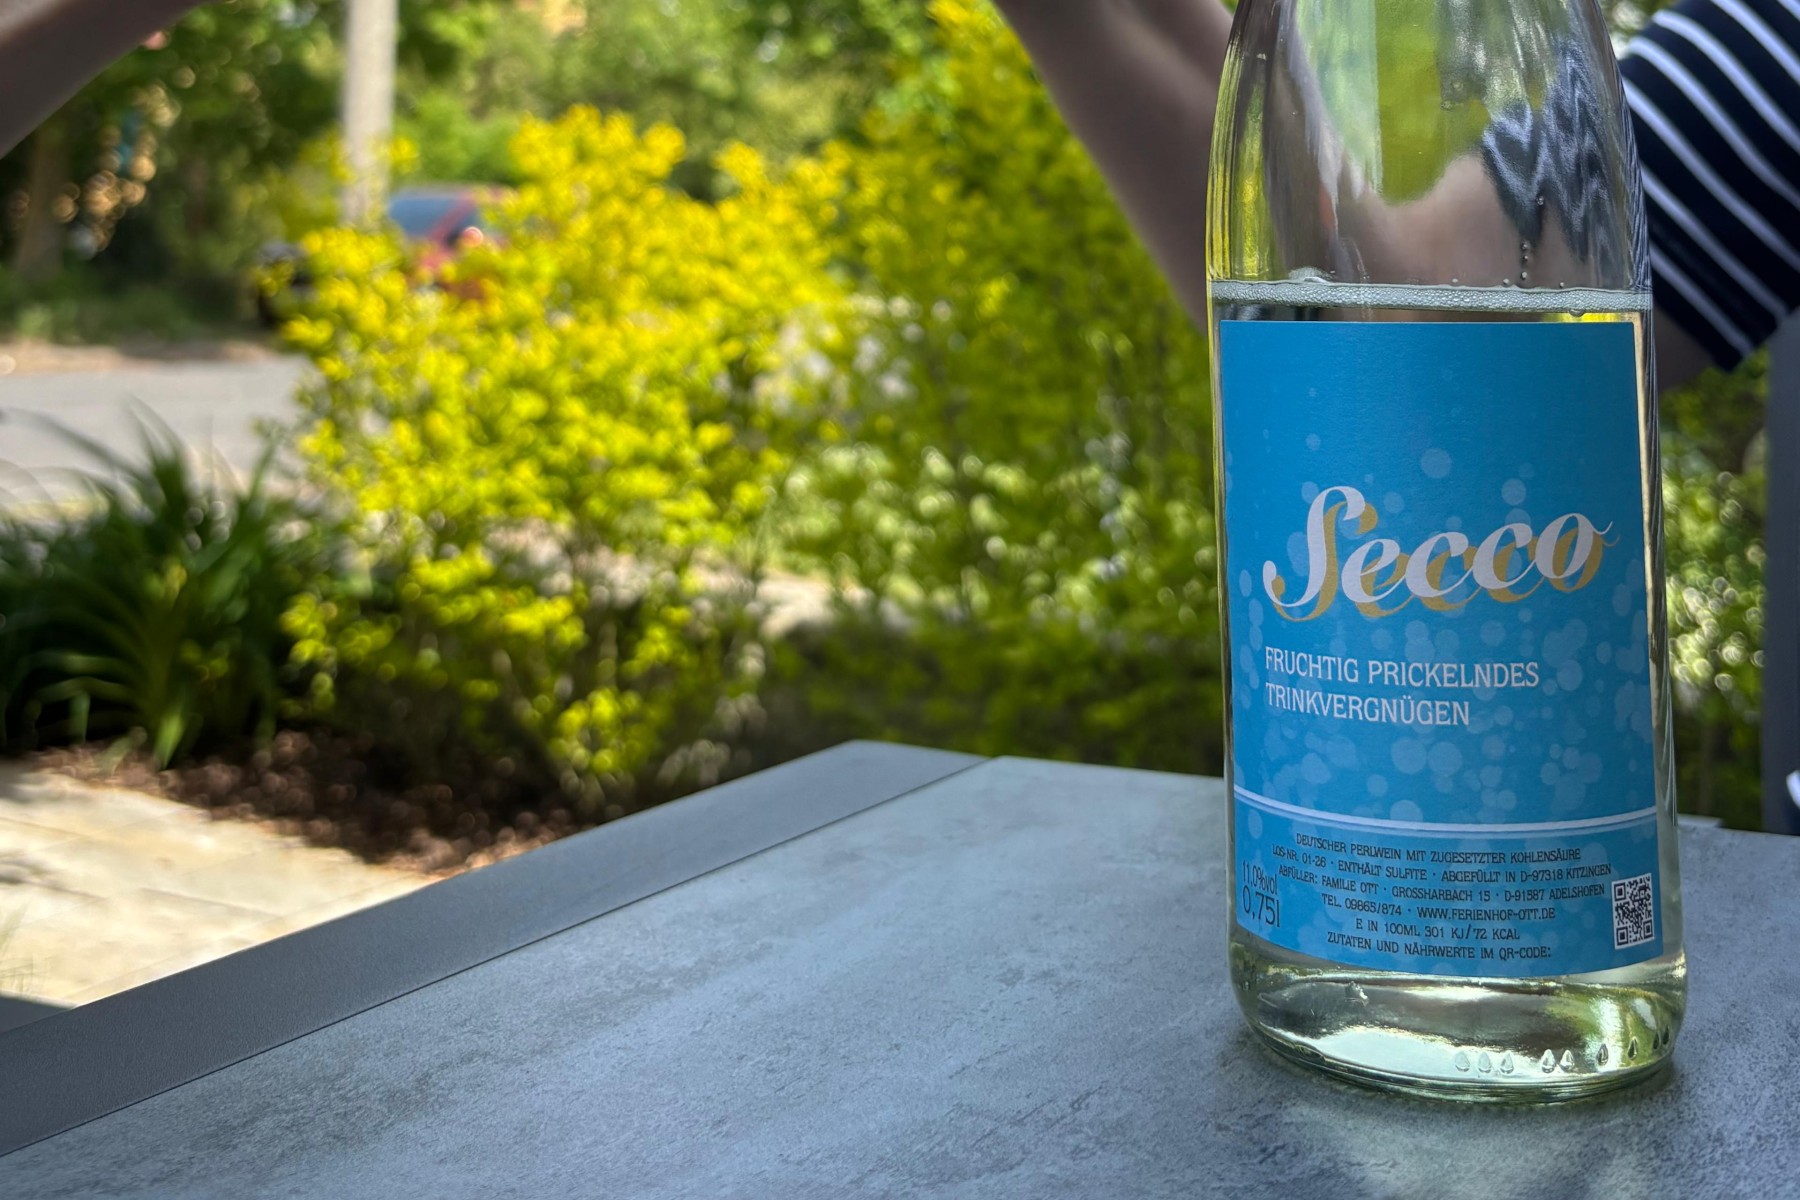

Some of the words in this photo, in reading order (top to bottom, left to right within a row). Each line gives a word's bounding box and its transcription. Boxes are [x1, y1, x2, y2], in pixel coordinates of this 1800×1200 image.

[1263, 486, 1620, 621] Secco
[1265, 646, 1359, 683] FRUCHTIG
[1368, 660, 1539, 688] PRICKELNDES
[1265, 682, 1470, 726] TRINKVERGNÜGEN
[1272, 843, 1298, 861] LOS-NR.
[1301, 852, 1327, 868] 01-26
[1338, 860, 1381, 877] ENTHÄLT
[1385, 866, 1427, 880] SULFITE
[1441, 869, 1500, 882] ABGEFÜLLT
[1505, 871, 1516, 882] IN
[1520, 869, 1563, 882] D-97318
[1566, 863, 1611, 880] KITZINGEN
[1296, 833, 1347, 856] DEUTSCHER
[1350, 843, 1401, 860] PERLWEIN
[1406, 849, 1426, 862] MIT
[1430, 851, 1506, 864] ZUGESETZTER
[1510, 848, 1581, 863] KOHLENSÄURE
[1278, 864, 1318, 885] ABFÜLLER:
[1321, 875, 1356, 892] FAMILIE
[1360, 882, 1379, 895] OTT
[1391, 885, 1473, 902] GROSSHARBACH
[1478, 890, 1491, 902] 15
[1504, 889, 1545, 902] D-91587
[1549, 884, 1605, 900] ADELSHOFEN
[1321, 893, 1342, 908] TEL.
[1344, 898, 1402, 916] 09865/874
[1417, 906, 1556, 921] WWW.FERIENHOF-OTT.DE
[1327, 931, 1372, 950] ZUTATEN
[1376, 940, 1399, 954] UND
[1404, 942, 1475, 959] NÄHRWERTE
[1481, 947, 1494, 959] IM
[1498, 946, 1551, 961] QR-CODE:
[1368, 920, 1378, 932] IN
[1384, 922, 1420, 936] 100ML
[1424, 925, 1445, 938] 301
[1492, 928, 1520, 941] KCAL
